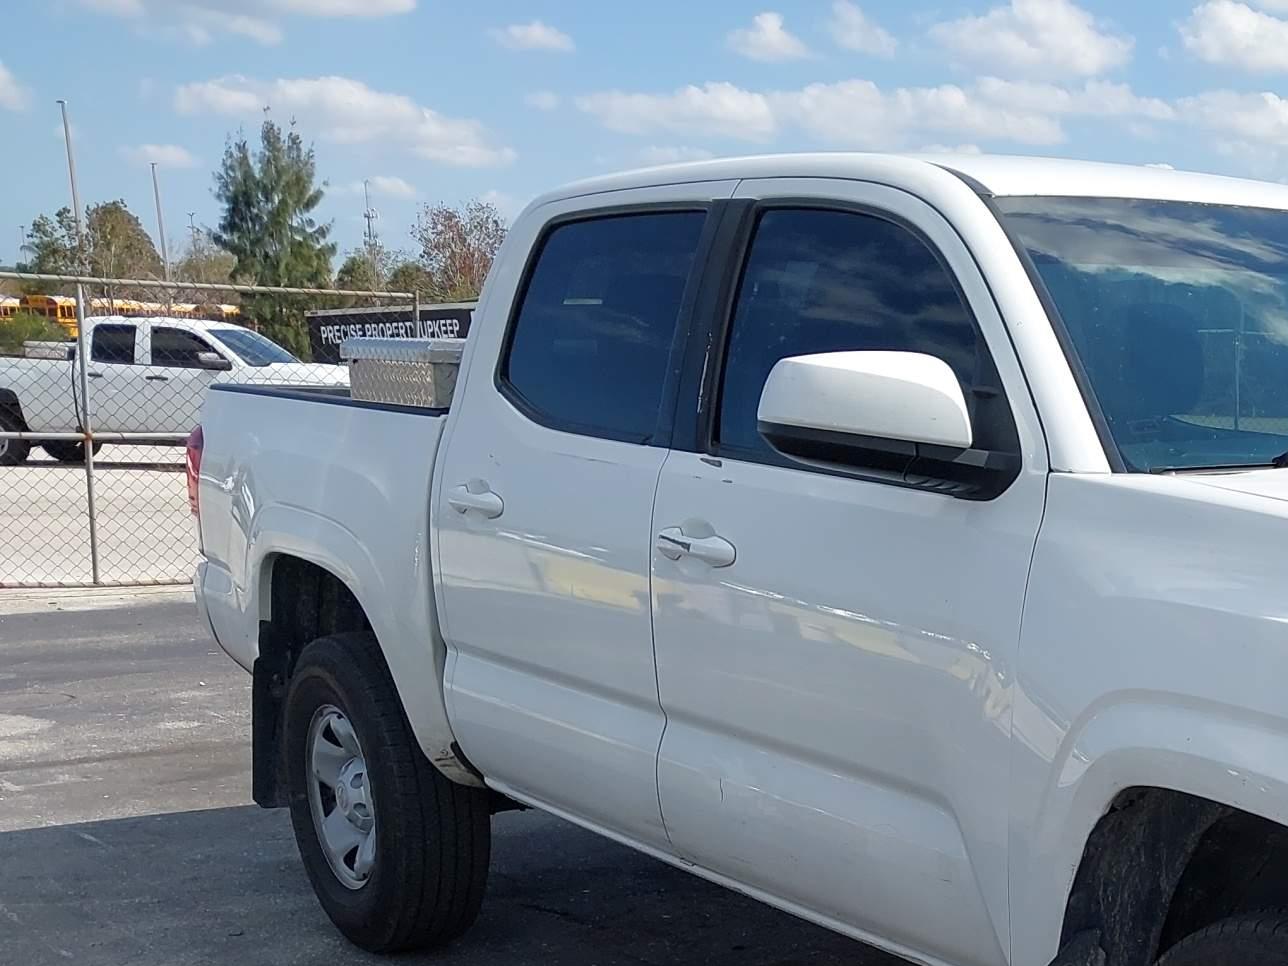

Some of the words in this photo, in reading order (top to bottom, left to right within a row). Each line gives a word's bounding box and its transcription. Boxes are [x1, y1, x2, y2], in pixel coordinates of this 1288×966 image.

[320, 324, 363, 344] PRECISE
[364, 321, 416, 338] PROPERT
[419, 319, 460, 339] UPKEEP
